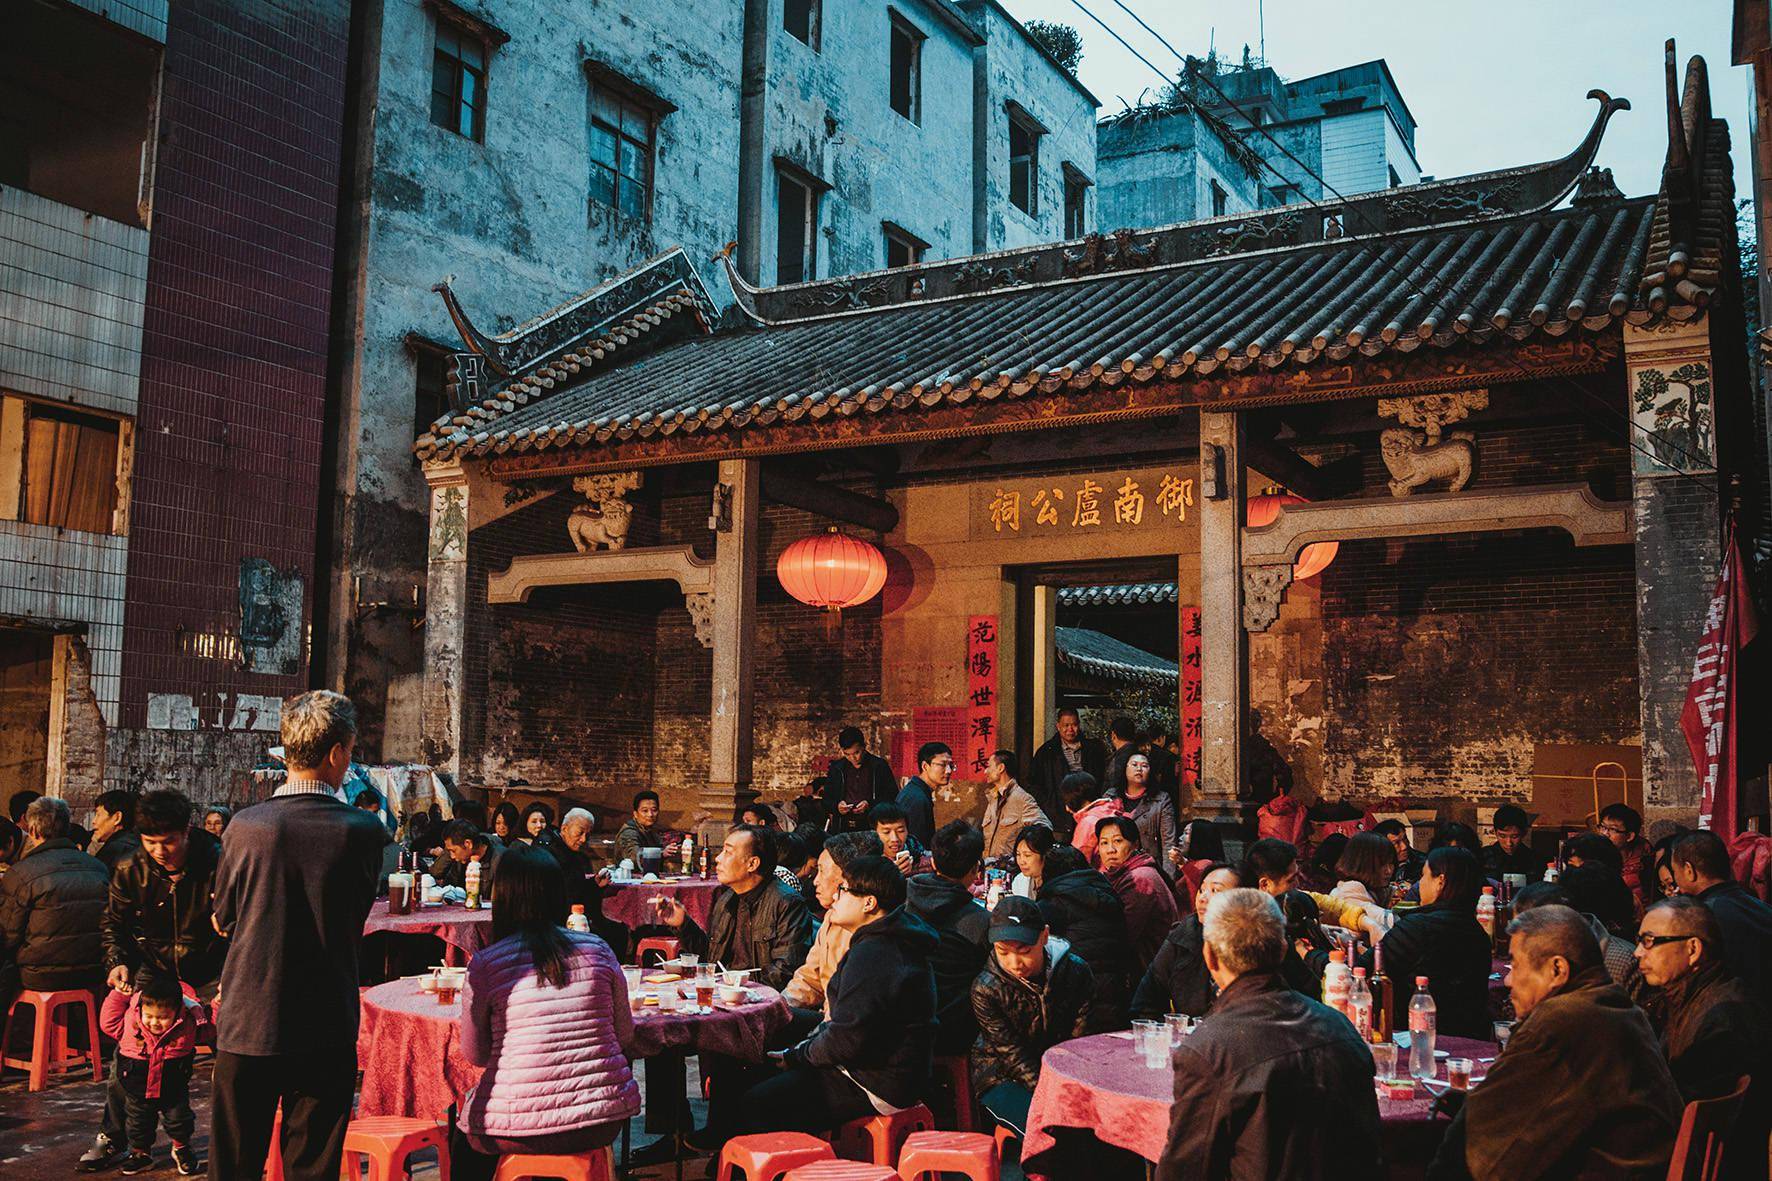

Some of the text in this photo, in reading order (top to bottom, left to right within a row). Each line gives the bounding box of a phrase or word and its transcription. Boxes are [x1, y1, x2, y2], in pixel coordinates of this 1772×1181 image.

[970, 620, 995, 774] 范陽世澤長
